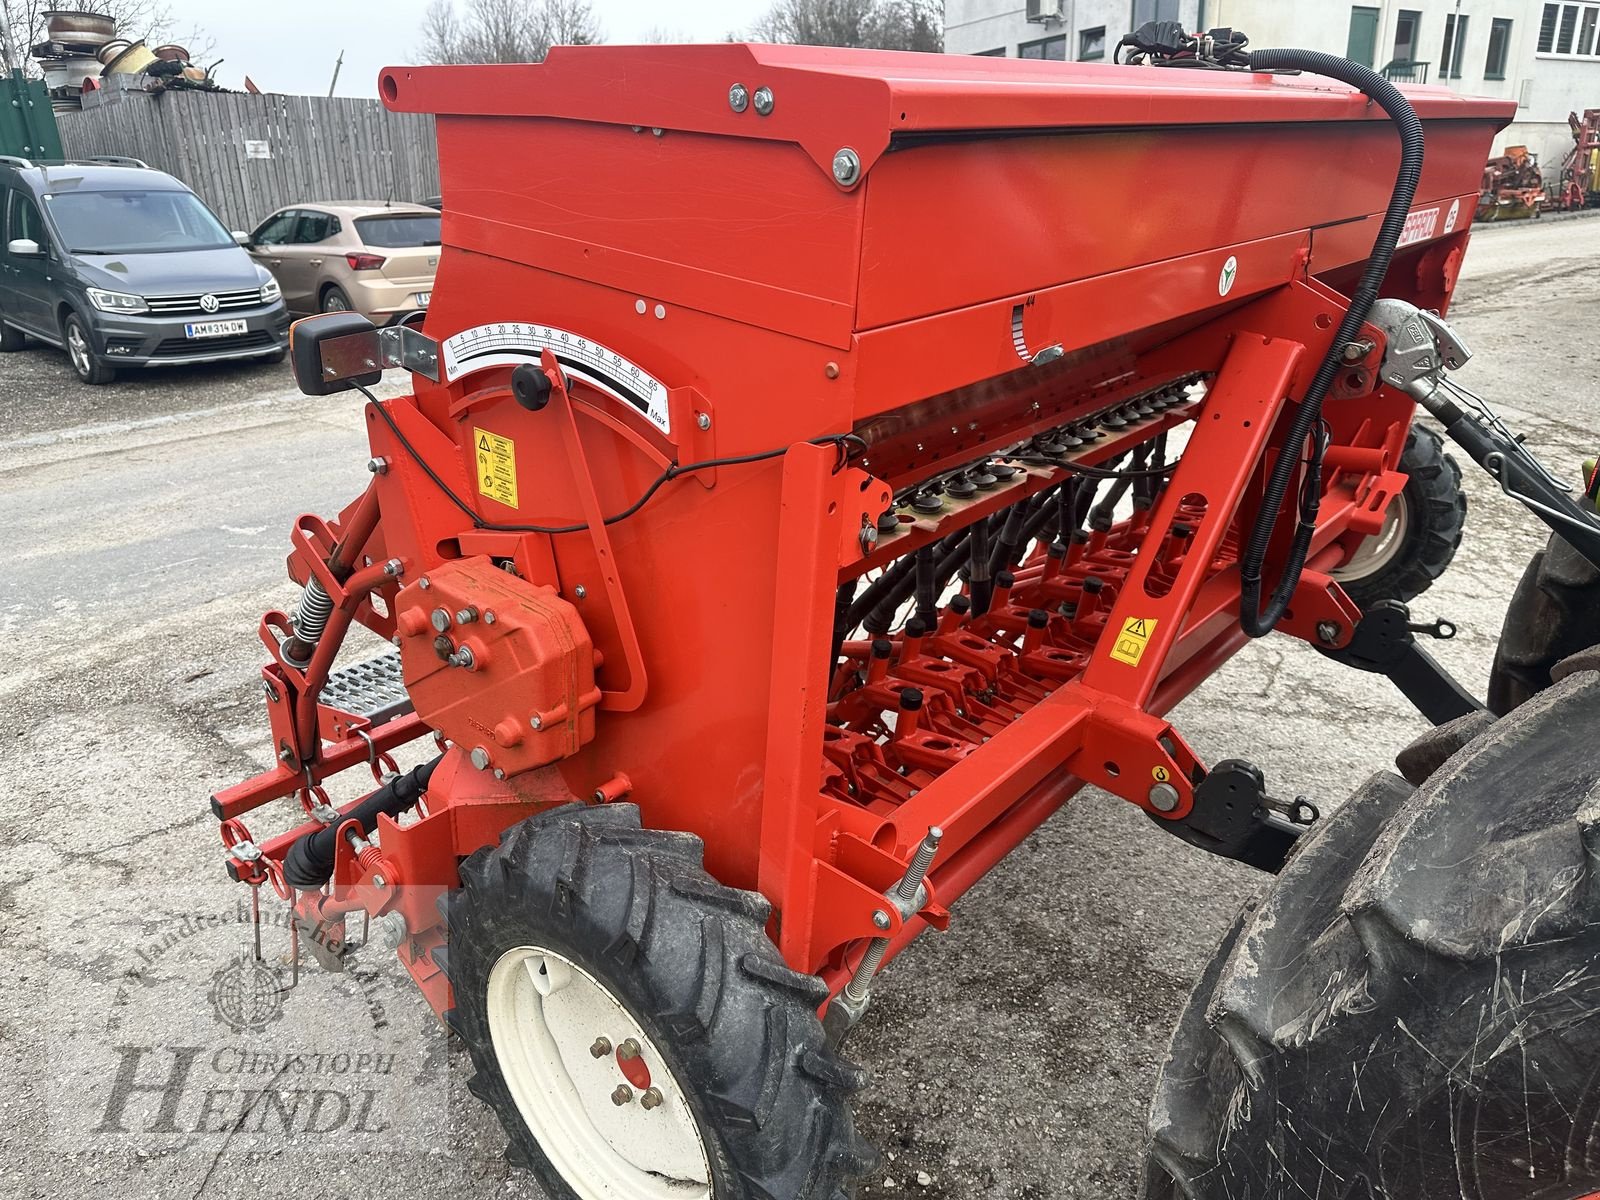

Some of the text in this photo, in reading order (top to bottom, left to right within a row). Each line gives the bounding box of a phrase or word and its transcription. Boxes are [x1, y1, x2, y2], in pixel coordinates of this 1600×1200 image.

[1400, 209, 1438, 243] SPARDO
[194, 322, 244, 335] AM 314 DW
[449, 340, 454, 348] 0
[471, 330, 478, 338] 10
[484, 326, 492, 335] 15
[498, 324, 506, 334] 20
[512, 324, 521, 334] 25
[528, 326, 536, 336] 30
[544, 328, 552, 339] 35
[560, 333, 569, 343] 40
[577, 339, 586, 349] 45
[594, 346, 604, 358] 50
[613, 355, 622, 367] 55
[630, 366, 640, 378] 60
[648, 379, 658, 391] 65
[448, 366, 458, 375] Min
[649, 409, 666, 427] Max
